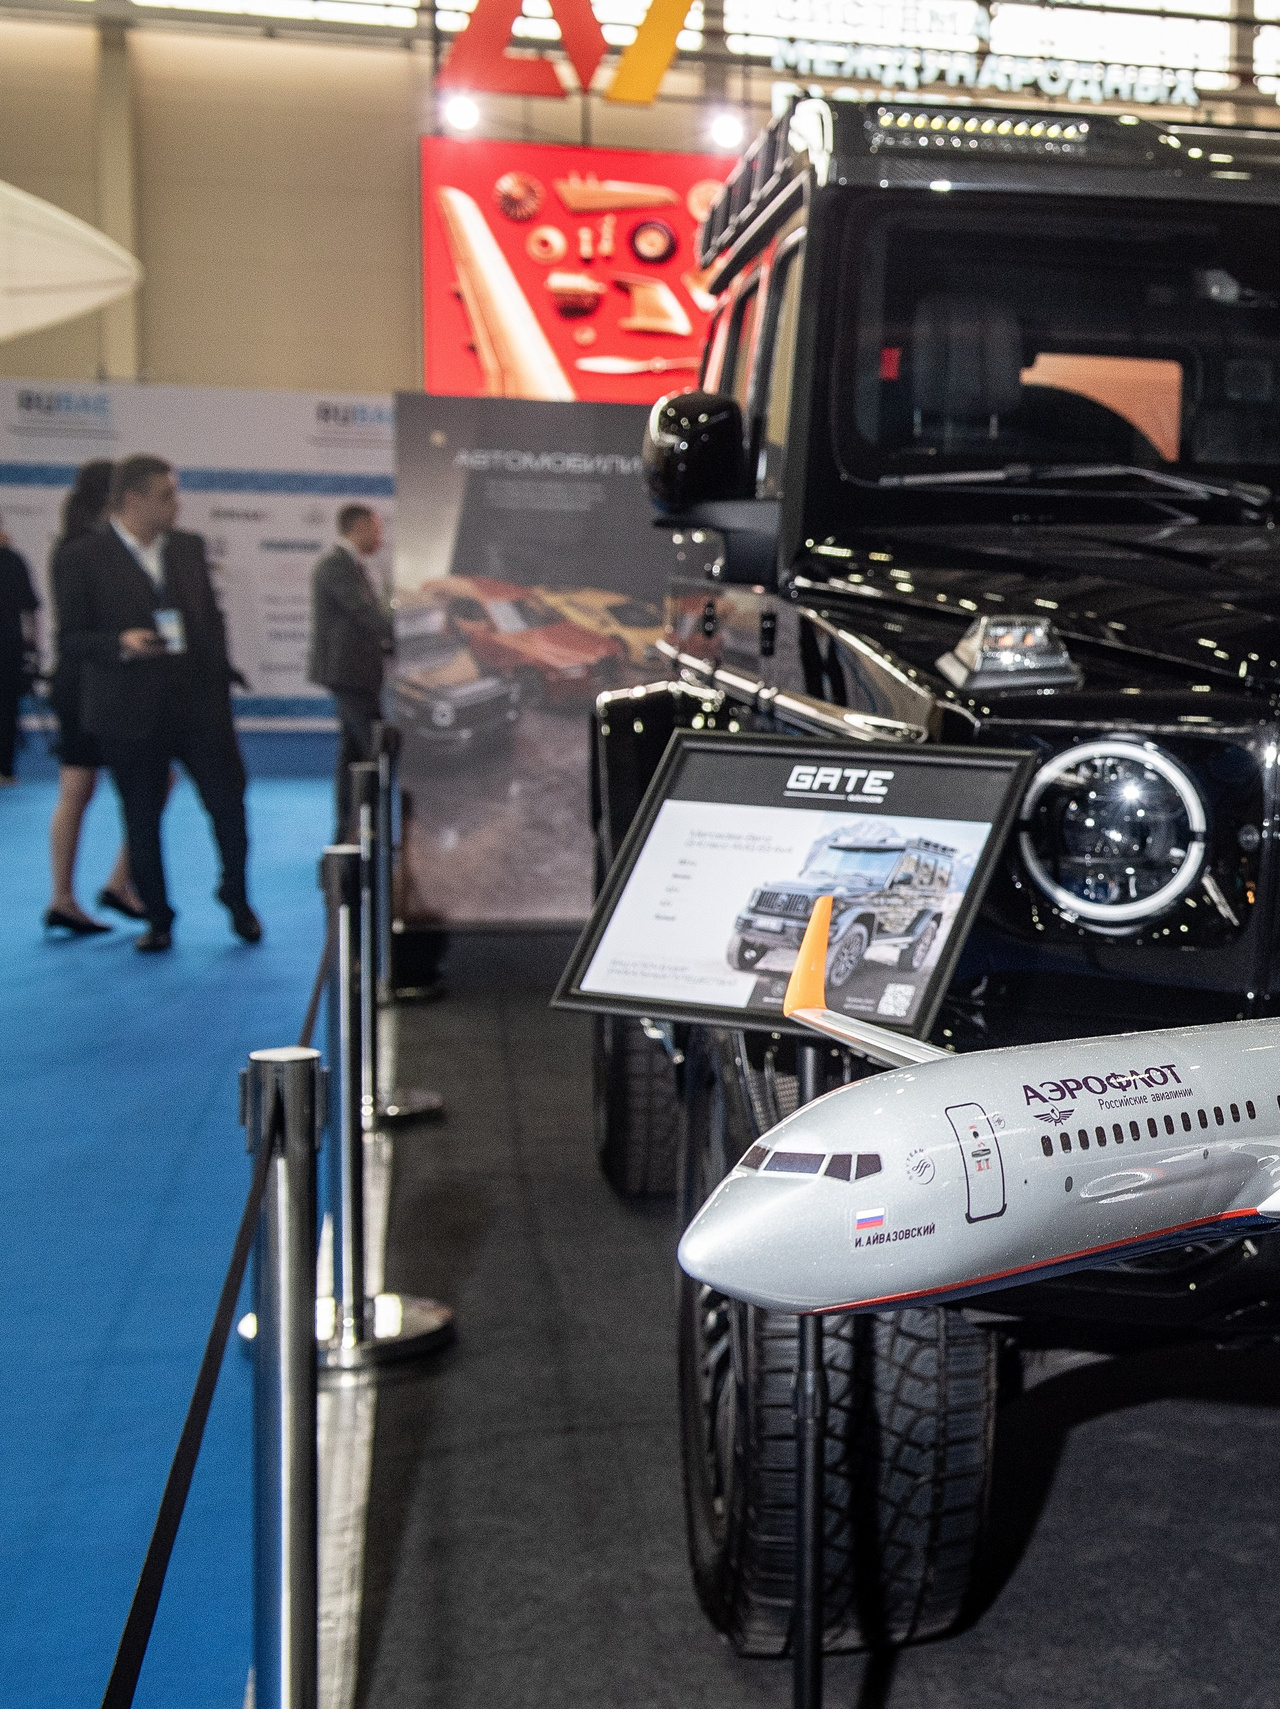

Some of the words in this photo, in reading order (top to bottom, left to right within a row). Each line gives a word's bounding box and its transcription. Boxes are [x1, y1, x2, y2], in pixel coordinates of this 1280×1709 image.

[786, 765, 895, 795] GATE
[1023, 1064, 1182, 1105] АЭРОФЛОТ
[1098, 1094, 1149, 1110] Российские
[1151, 1088, 1194, 1103] авиалинии
[854, 1237, 864, 1248] И.
[865, 1222, 936, 1246] АЙВАЗОВСКИЙ
